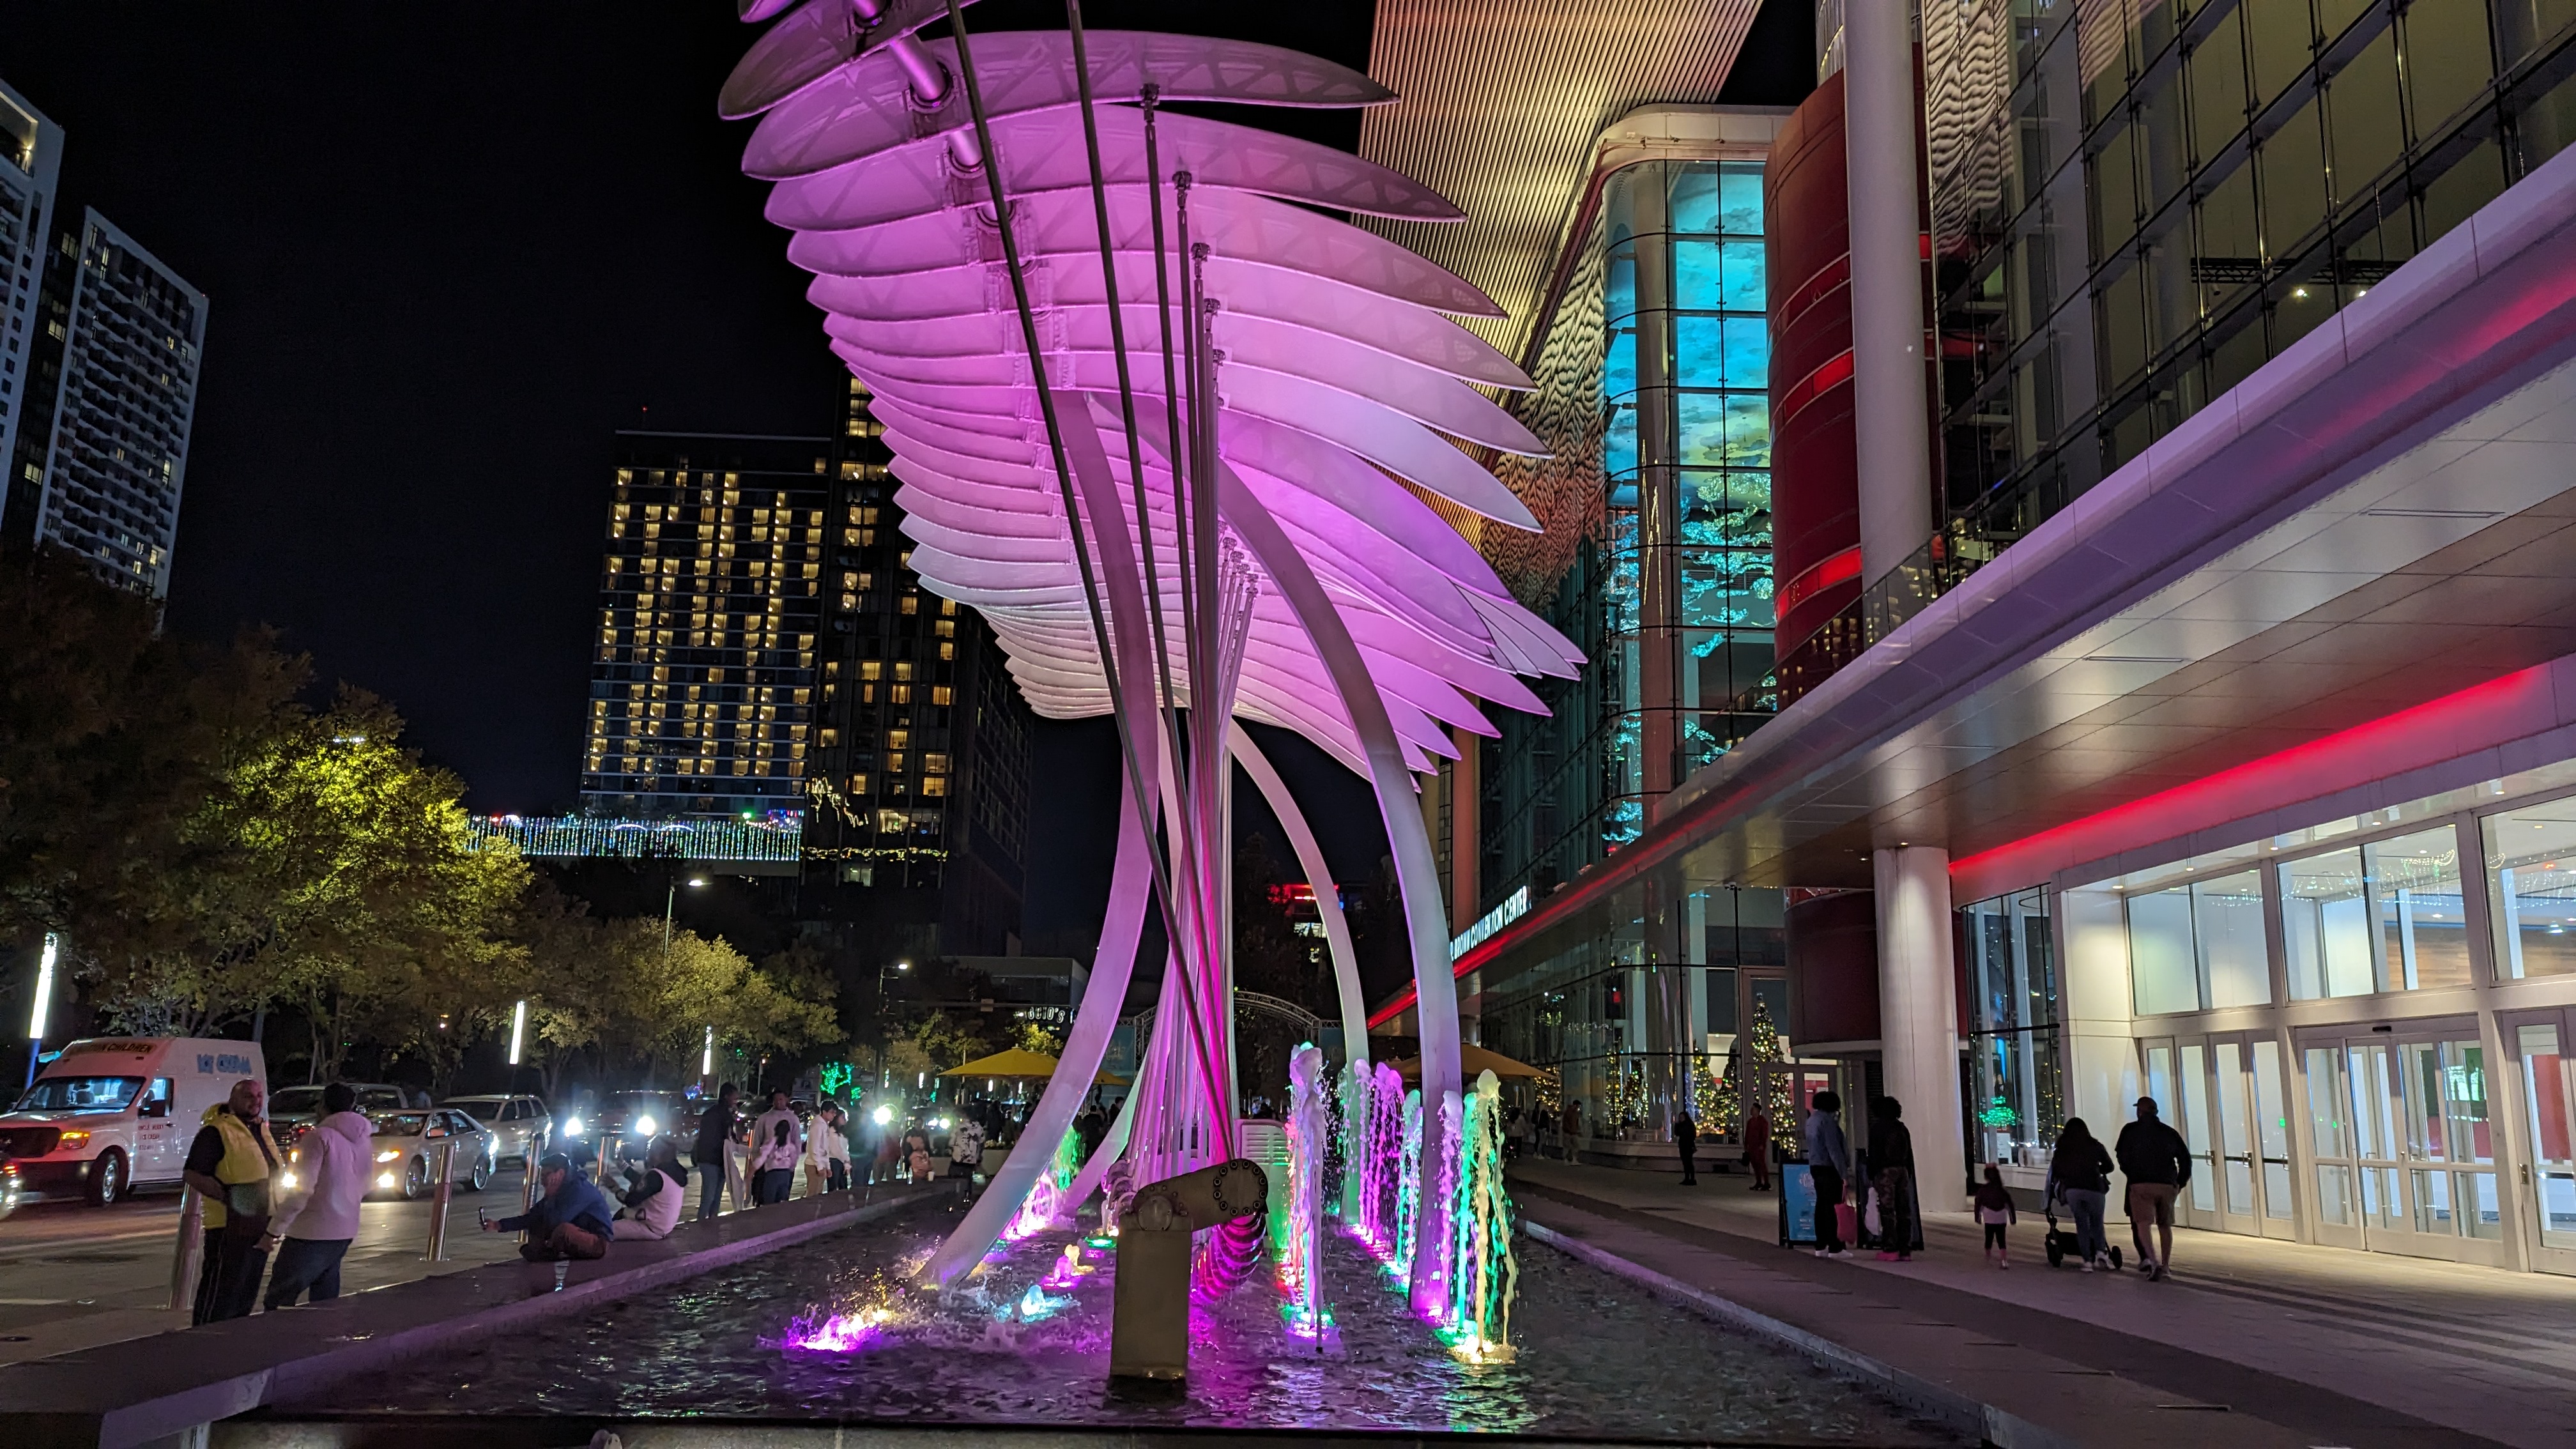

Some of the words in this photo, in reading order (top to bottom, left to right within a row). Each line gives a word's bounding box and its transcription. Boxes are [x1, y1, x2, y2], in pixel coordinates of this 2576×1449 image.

[1454, 929, 1471, 960] BROWN
[1471, 903, 1503, 949] CONVENTION
[1504, 885, 1528, 926] CENTER
[107, 1043, 152, 1053] CHILDREN
